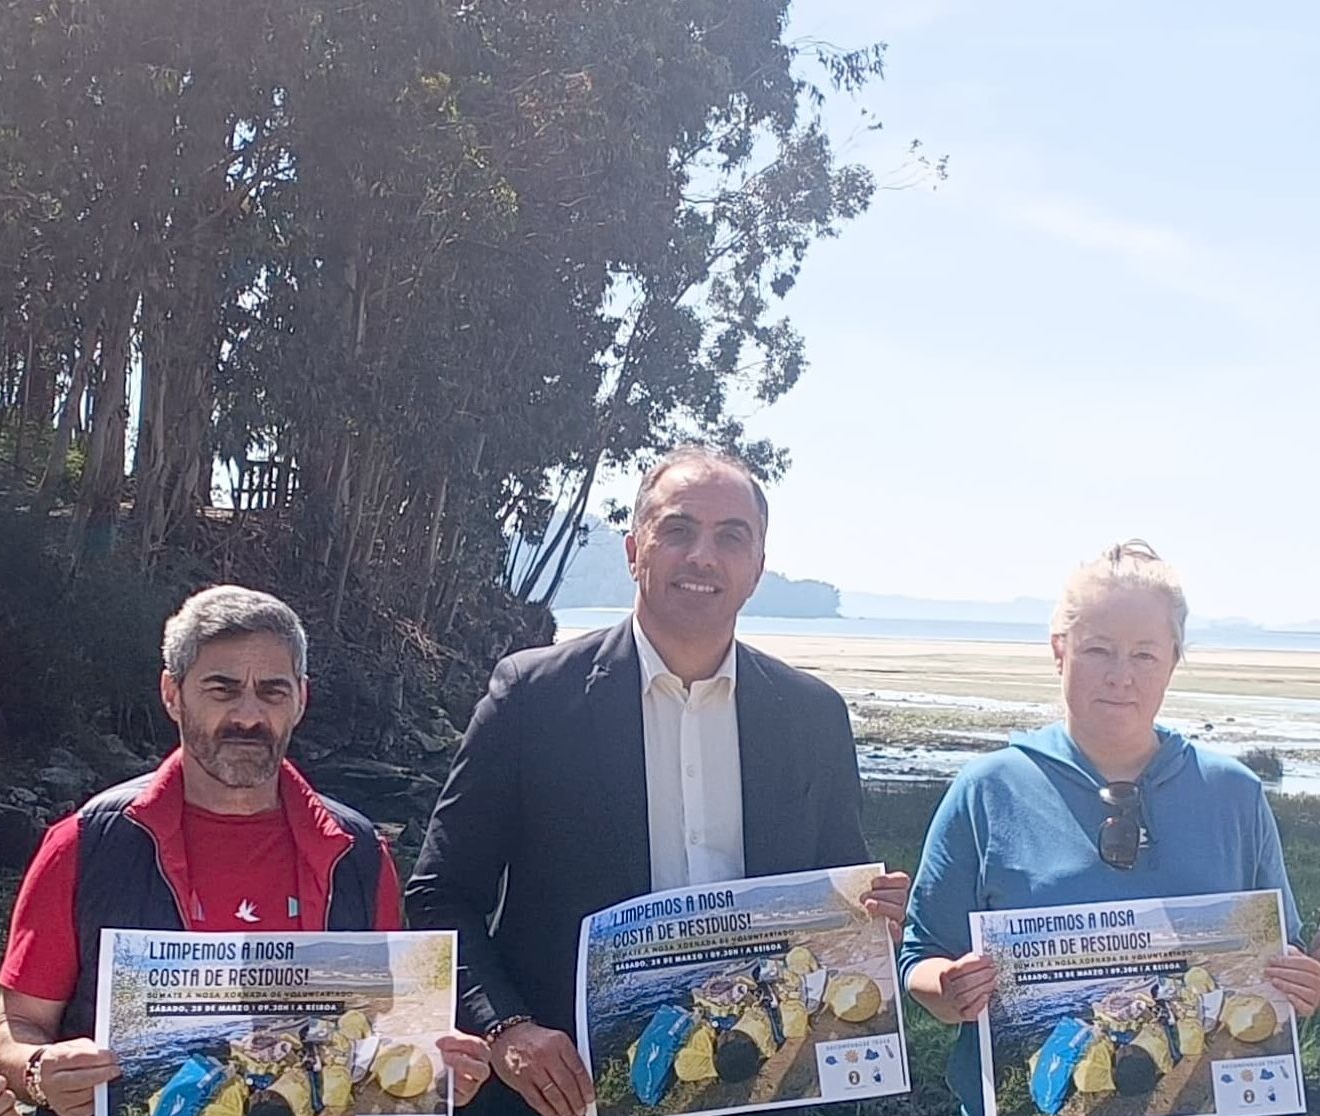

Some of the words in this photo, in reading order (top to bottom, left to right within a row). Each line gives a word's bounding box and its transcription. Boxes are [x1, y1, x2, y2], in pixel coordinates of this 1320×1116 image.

[613, 897, 682, 927] LIMPEMOS
[686, 895, 694, 912] A
[698, 890, 734, 911] NOSA
[614, 926, 654, 948] COSTA
[657, 923, 674, 940] DE
[679, 912, 751, 937] RESIDUOS!
[1010, 914, 1084, 935] LIMPEMOS
[1088, 912, 1096, 929] A
[1100, 909, 1135, 928] NOSA
[150, 941, 236, 960] LIMPEMOS
[241, 942, 250, 960] A
[256, 942, 294, 960] NOSA
[1012, 939, 1056, 958] COSTA
[1060, 938, 1077, 955] DE
[1081, 932, 1151, 953] RESIDUOS!
[675, 953, 703, 962] MARZO
[149, 968, 199, 987] COSTA
[205, 969, 223, 986] DE
[229, 968, 309, 986] RESIDUOS!
[1076, 968, 1103, 977] MARZO
[218, 1004, 249, 1012] MARZO
